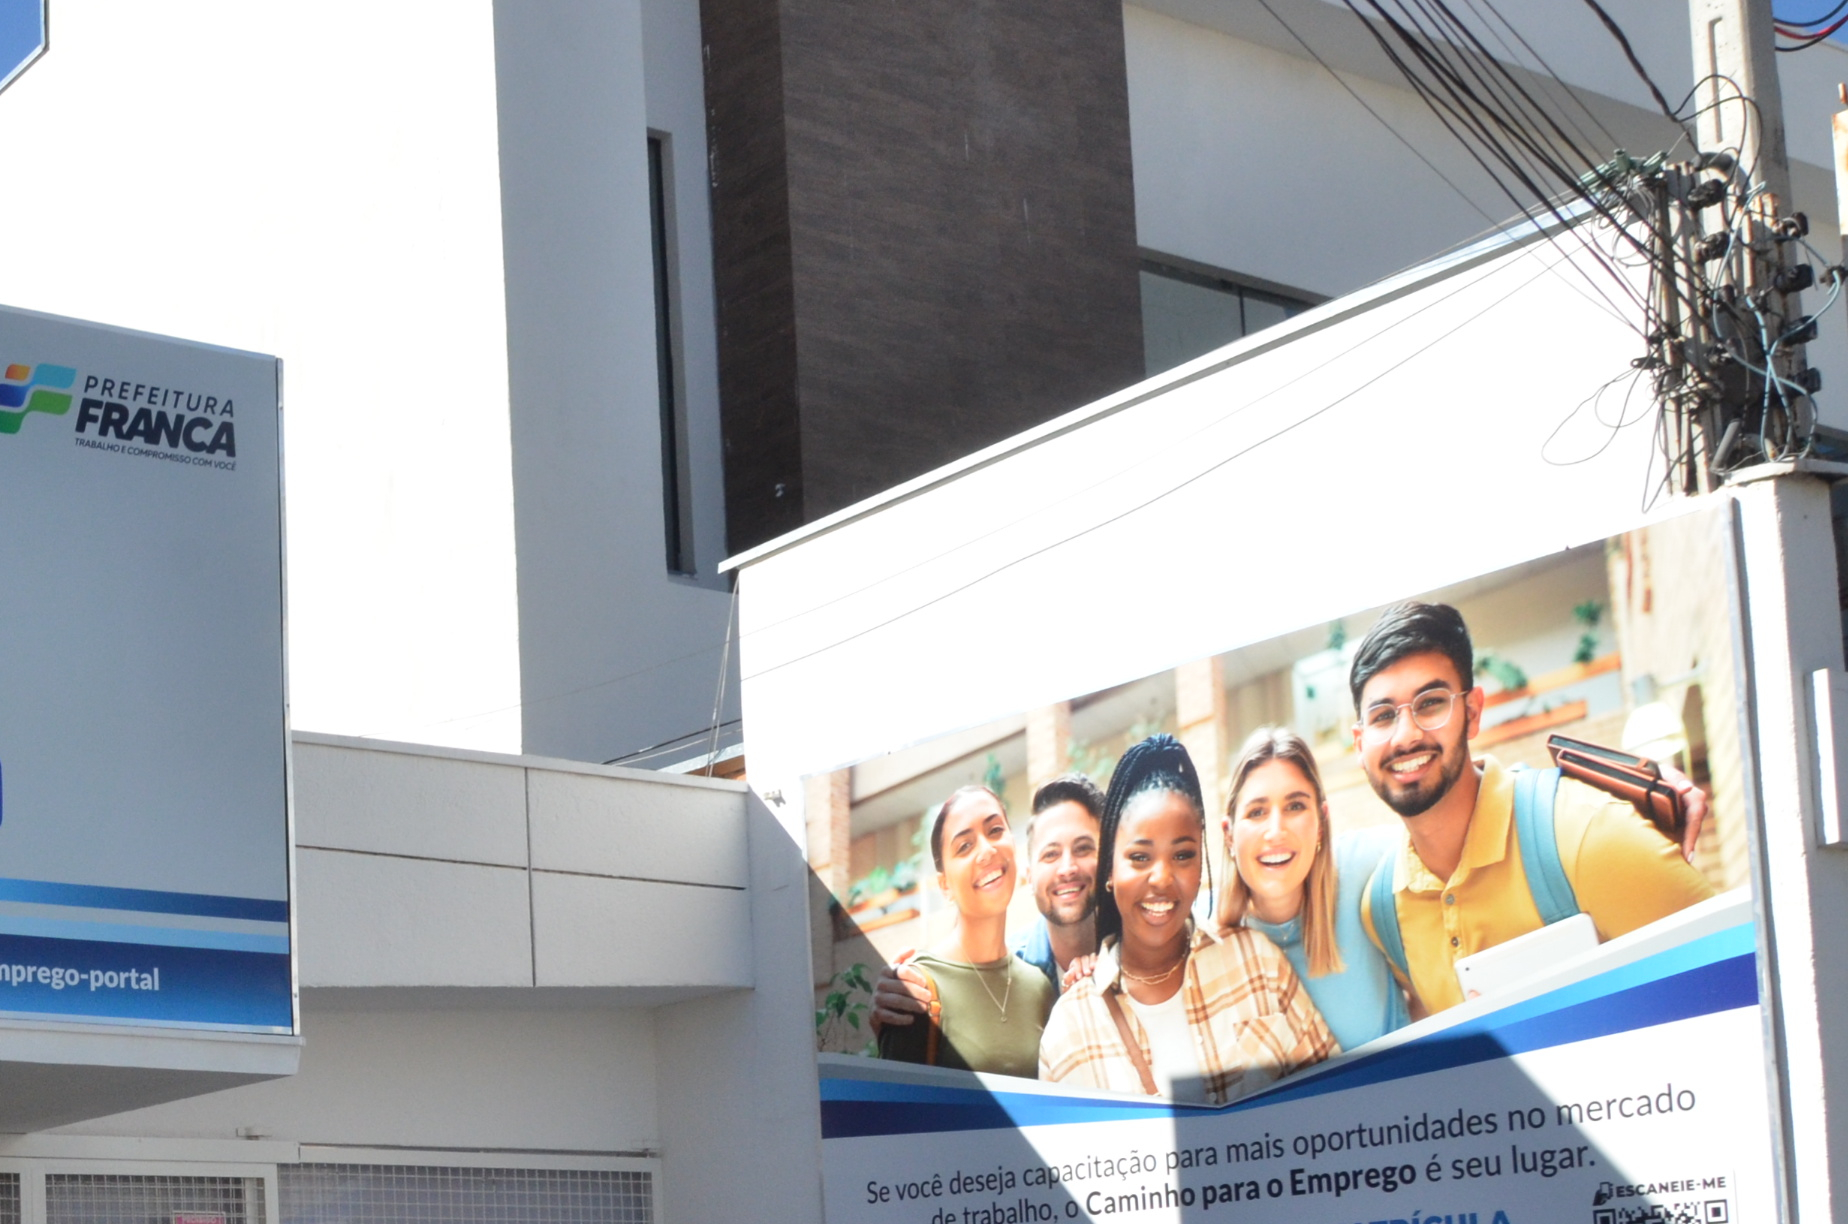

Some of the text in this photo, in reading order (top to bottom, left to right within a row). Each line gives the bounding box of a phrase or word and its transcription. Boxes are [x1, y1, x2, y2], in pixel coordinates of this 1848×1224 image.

[84, 375, 234, 418] PREFEITURA
[75, 398, 237, 458] FRANCA
[75, 437, 120, 453] TRABALHO
[127, 447, 191, 464] COMPROMISSO
[192, 457, 213, 468] COM
[867, 1083, 1696, 1204] Se você deseja capacitação para mais oportunidades no mercado
[1065, 1200, 1079, 1218] o
[1086, 1182, 1195, 1216] Caminho
[1202, 1178, 1260, 1211] para
[1267, 1177, 1283, 1198] o
[1290, 1163, 1416, 1198] Emprego
[1425, 1153, 1442, 1182] é
[1452, 1153, 1501, 1180] seu
[1512, 1144, 1596, 1178] lugar.
[1616, 1176, 1726, 1198] ESCANEIE-ME
